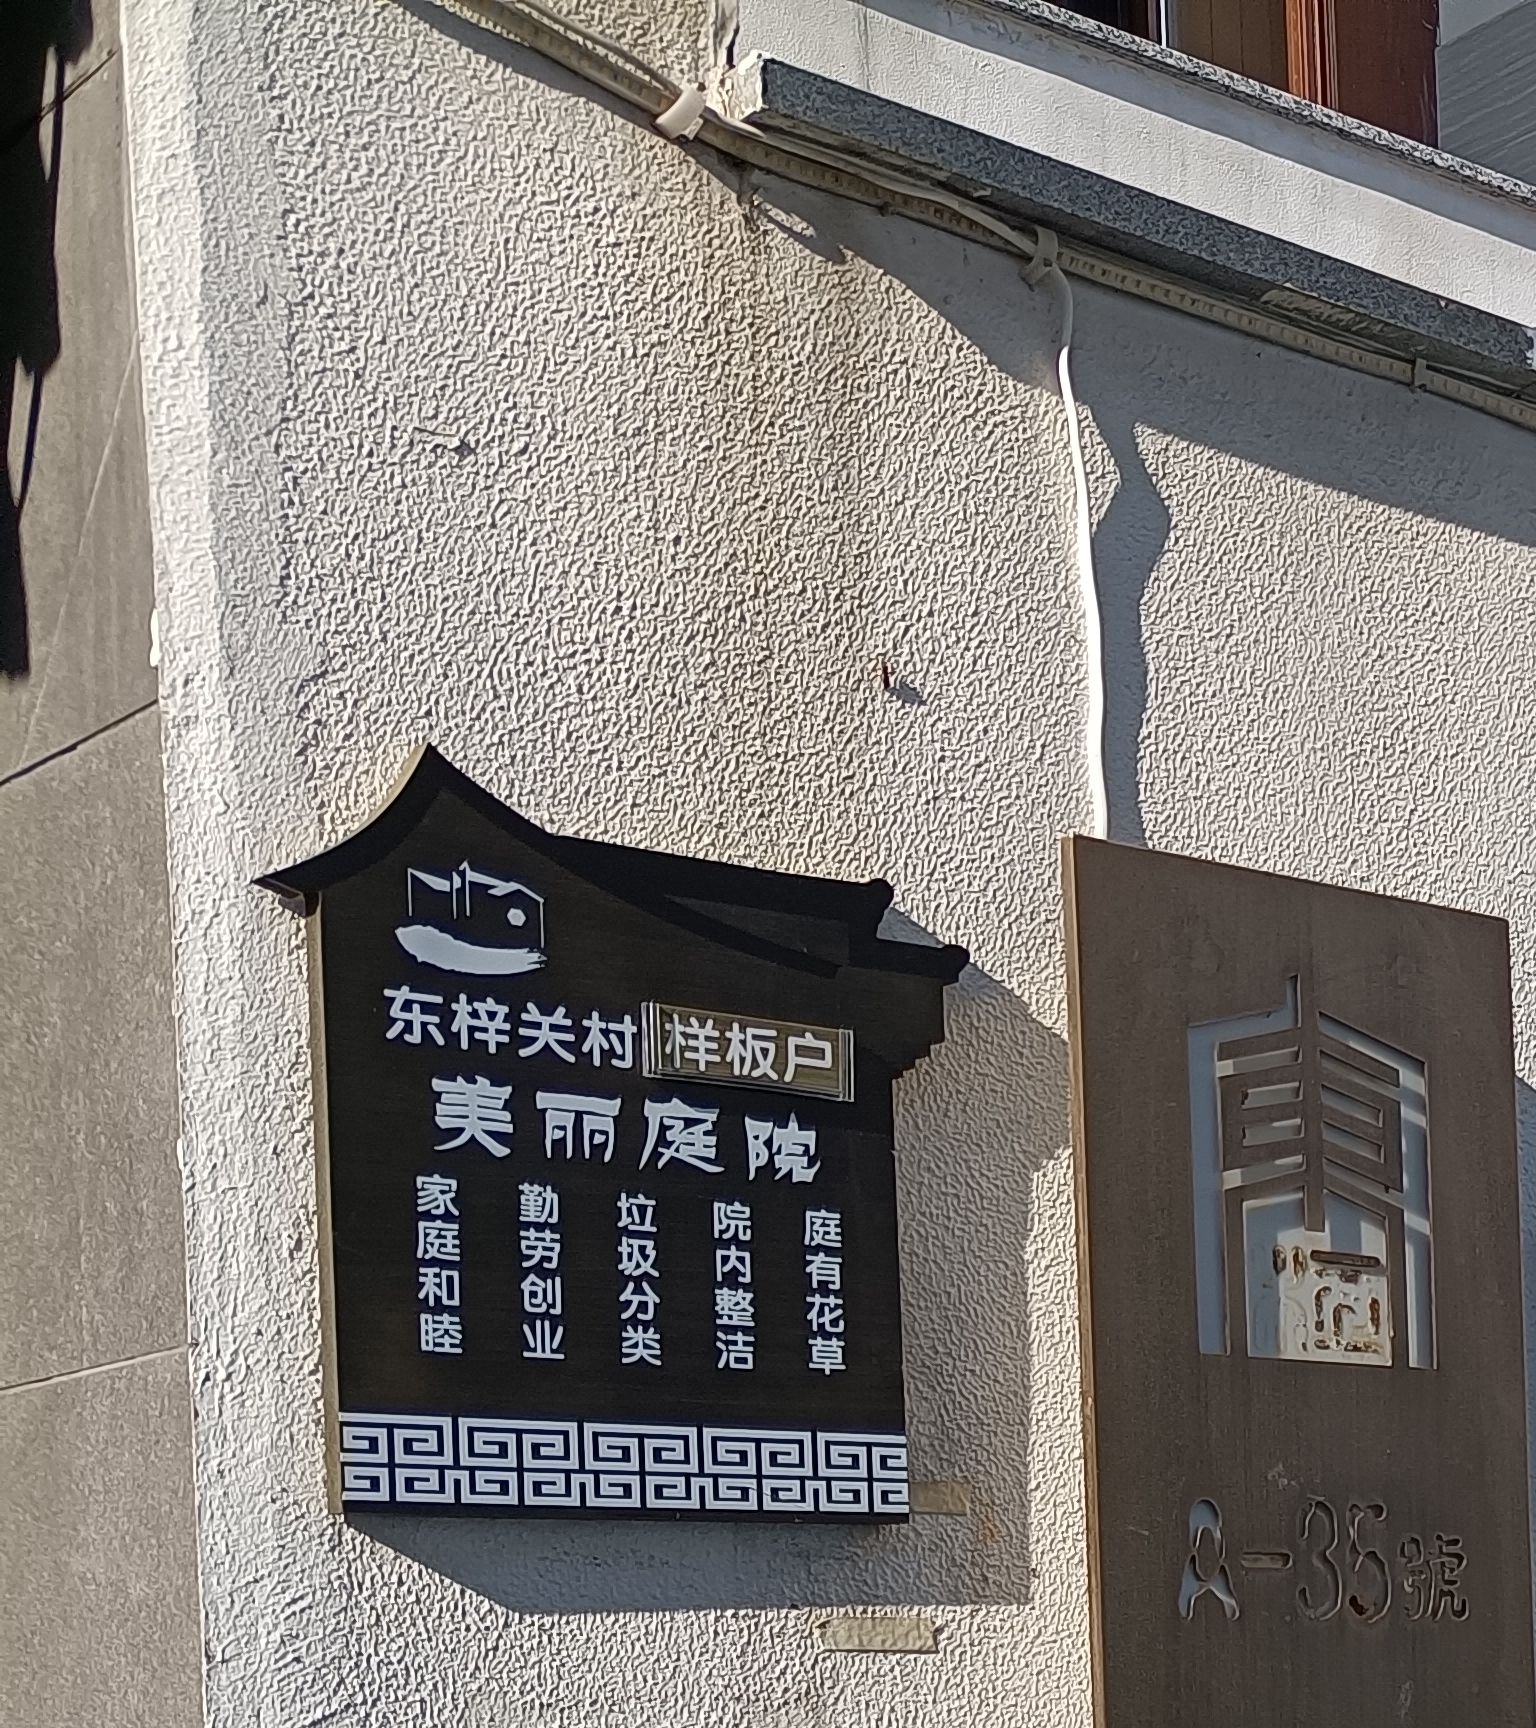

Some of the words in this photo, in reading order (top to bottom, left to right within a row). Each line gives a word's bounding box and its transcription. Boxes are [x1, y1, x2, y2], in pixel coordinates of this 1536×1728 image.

[382, 985, 638, 1069] 东梓关村
[663, 1014, 834, 1083] 样板户
[431, 1074, 822, 1184] 美丽庭院
[414, 1173, 464, 1357] 家庭和睦
[517, 1182, 566, 1361] 勤劳创业
[615, 1192, 663, 1367] 垃圾分类
[712, 1201, 756, 1371] 院内整洁
[803, 1208, 847, 1376] 庭有花草
